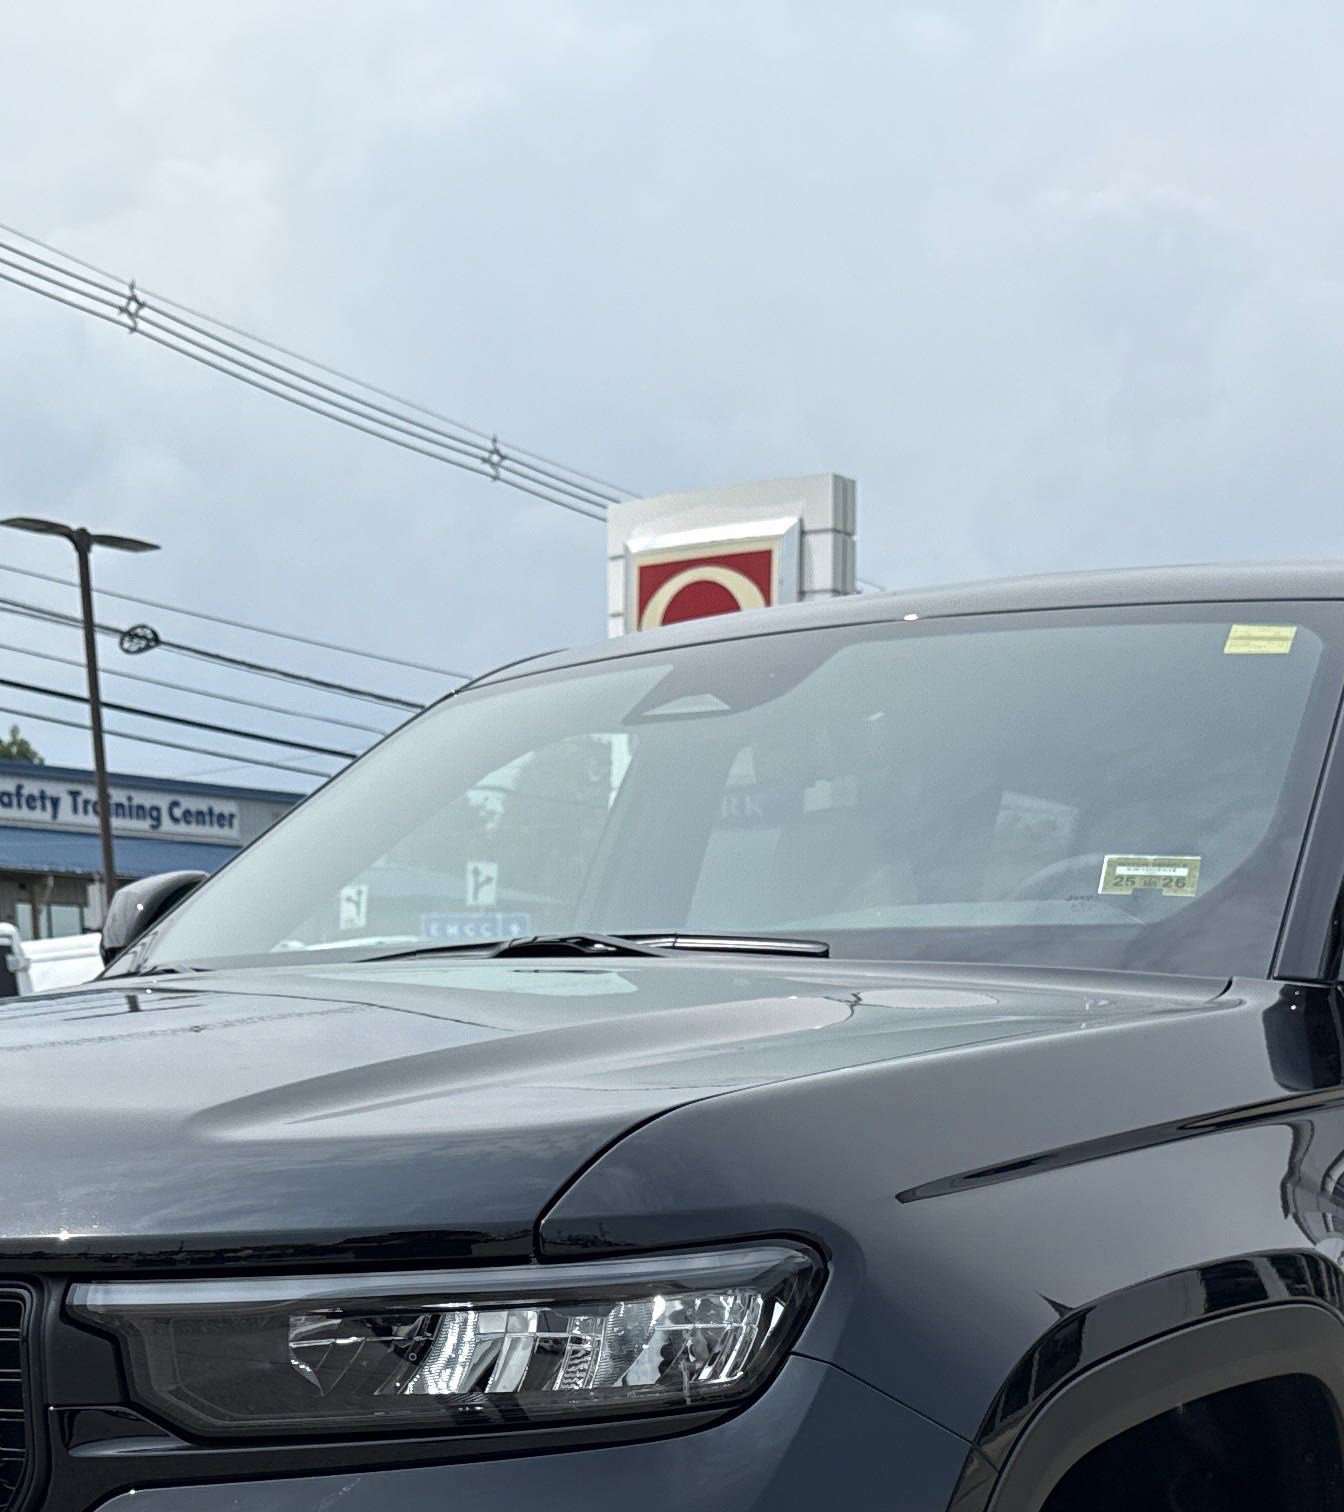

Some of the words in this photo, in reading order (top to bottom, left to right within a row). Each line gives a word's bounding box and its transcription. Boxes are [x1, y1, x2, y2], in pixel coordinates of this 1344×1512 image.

[167, 801, 237, 829] Center
[1112, 876, 1136, 888] 25
[1162, 877, 1186, 889] 26
